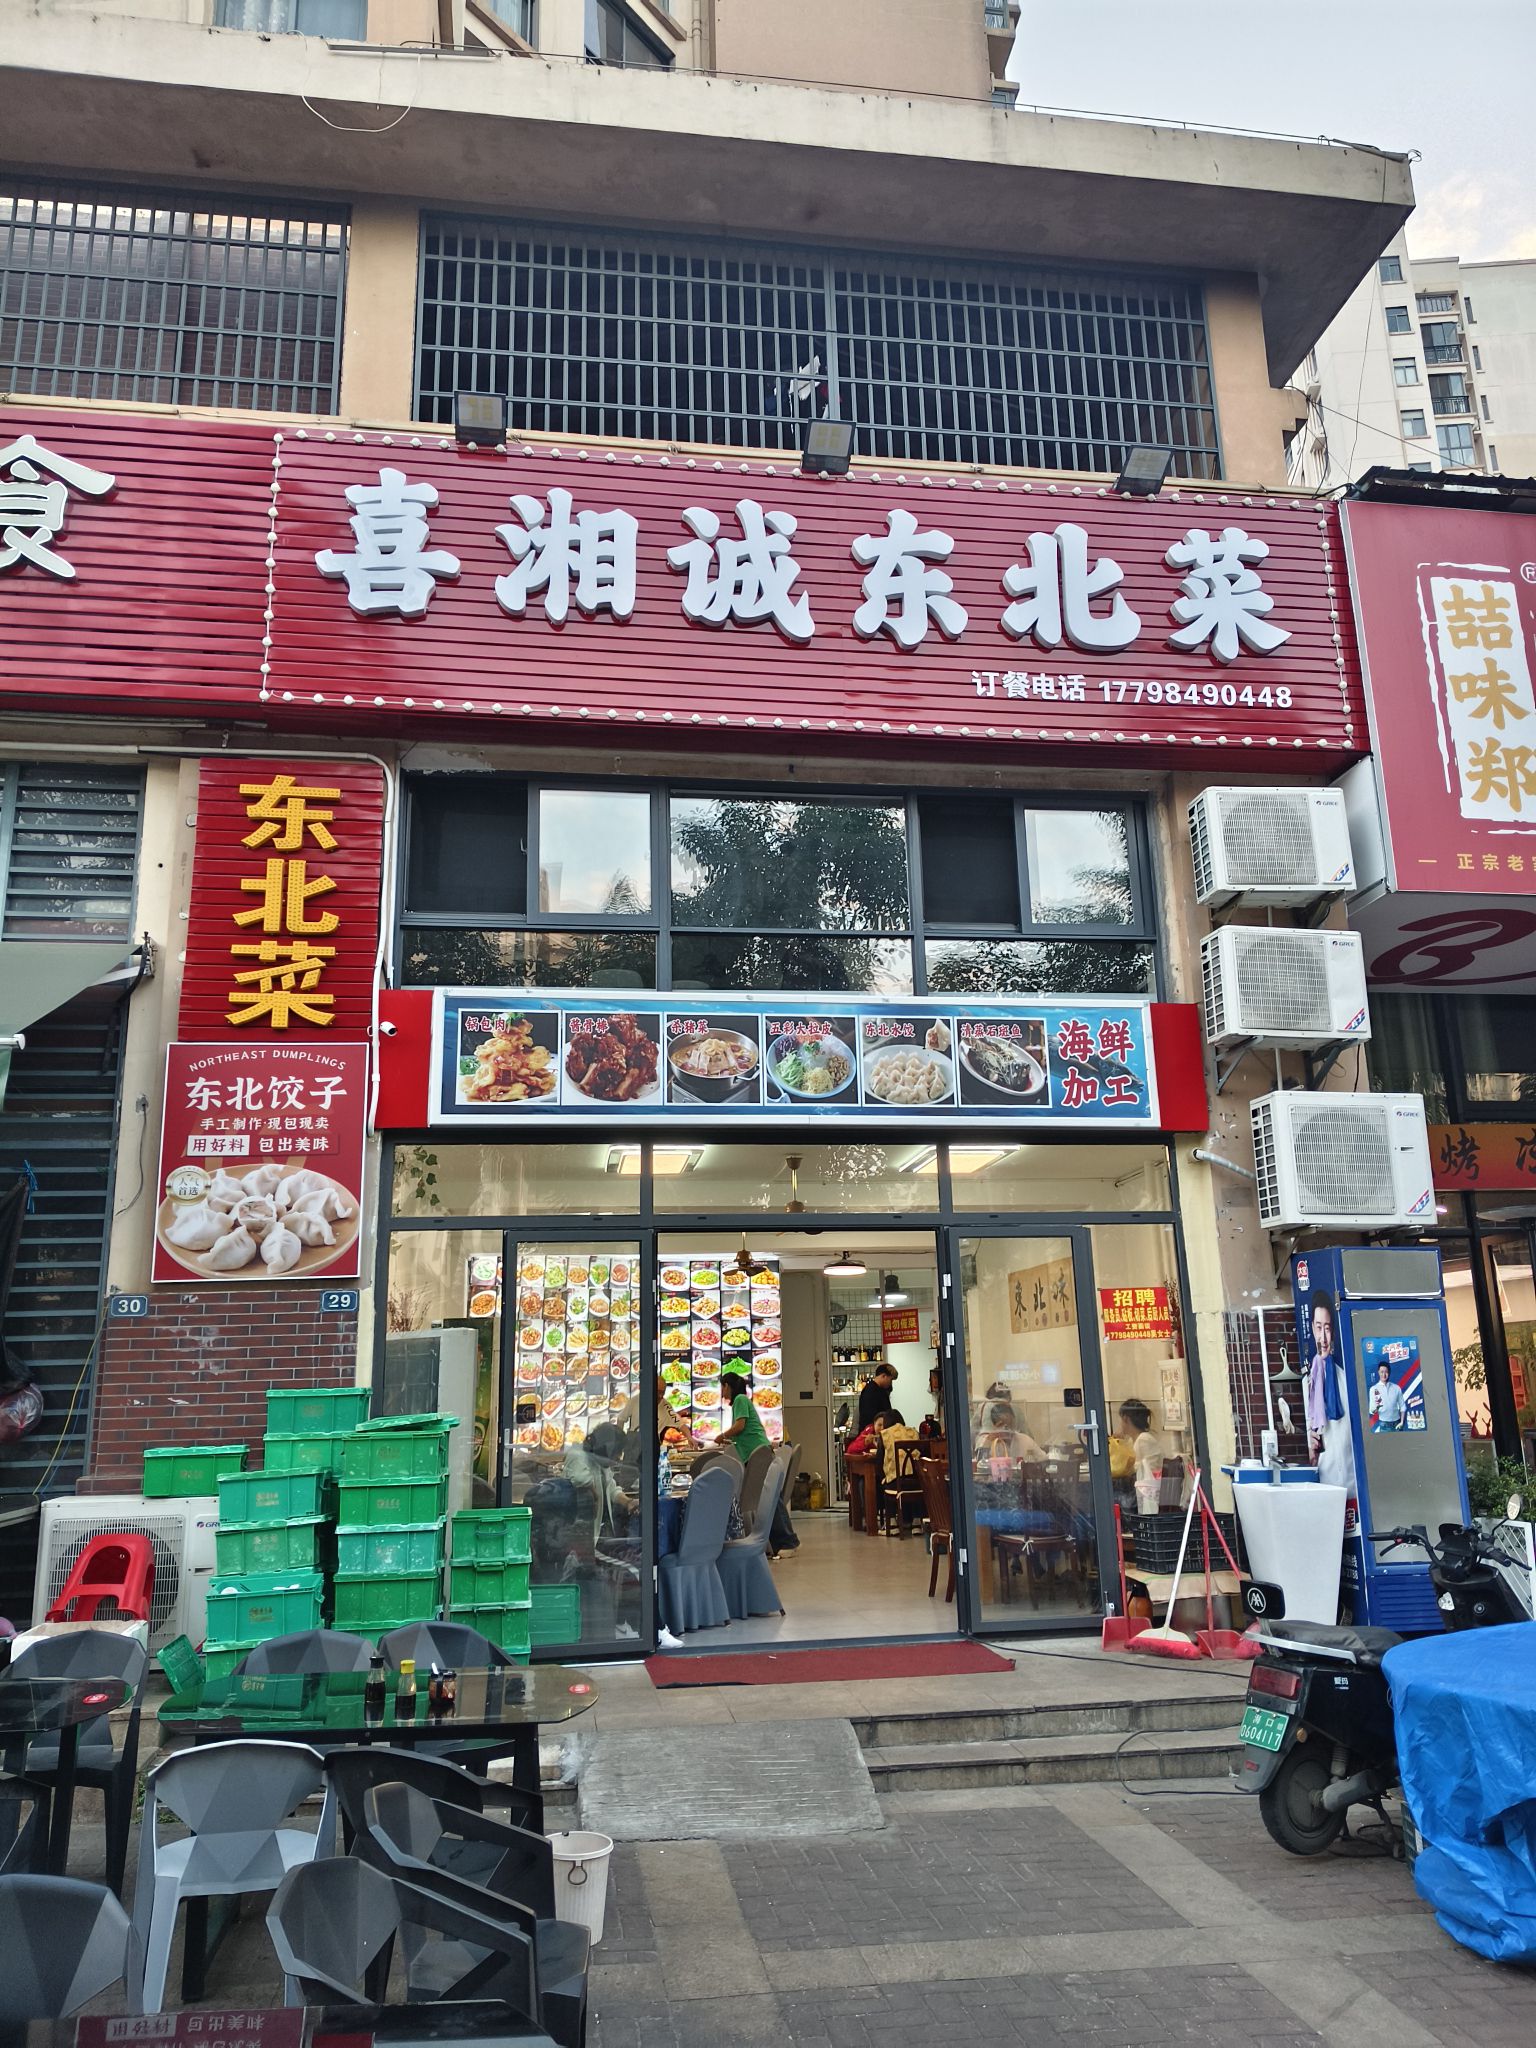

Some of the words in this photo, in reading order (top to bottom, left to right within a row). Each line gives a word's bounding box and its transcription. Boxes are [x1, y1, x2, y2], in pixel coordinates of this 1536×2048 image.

[314, 466, 1293, 664] 喜湘诚东北菜
[971, 671, 1087, 702] 订餐电话
[1099, 680, 1293, 709] 17798490448
[1441, 583, 1536, 813] 喆味郑
[1457, 853, 1536, 872] 正宗老
[224, 774, 341, 1030] 东北菜
[465, 1016, 508, 1033] 锅包肉
[568, 1017, 610, 1035] 酱骨棒
[671, 1019, 710, 1035] 杀猪菜
[770, 1020, 833, 1036] 五彩大拉皮
[865, 1022, 916, 1038] 东北水饺
[960, 1023, 1023, 1039] 清蒸石斑鱼
[1057, 1018, 1136, 1064] 海鲜
[189, 1050, 267, 1072] NORTHEAST
[272, 1049, 347, 1071] DUMPLINGS
[184, 1075, 348, 1112] 东北饺子
[1060, 1066, 1140, 1109] 加工
[192, 1138, 245, 1153] 用好料
[259, 1137, 329, 1153] 包出美味
[178, 1177, 199, 1186] 人气
[178, 1186, 199, 1196] 首选
[118, 1299, 141, 1314] 30
[328, 1294, 351, 1308] 29
[1113, 1289, 1156, 1307] 招聘
[1240, 1724, 1282, 1746] 0604117
